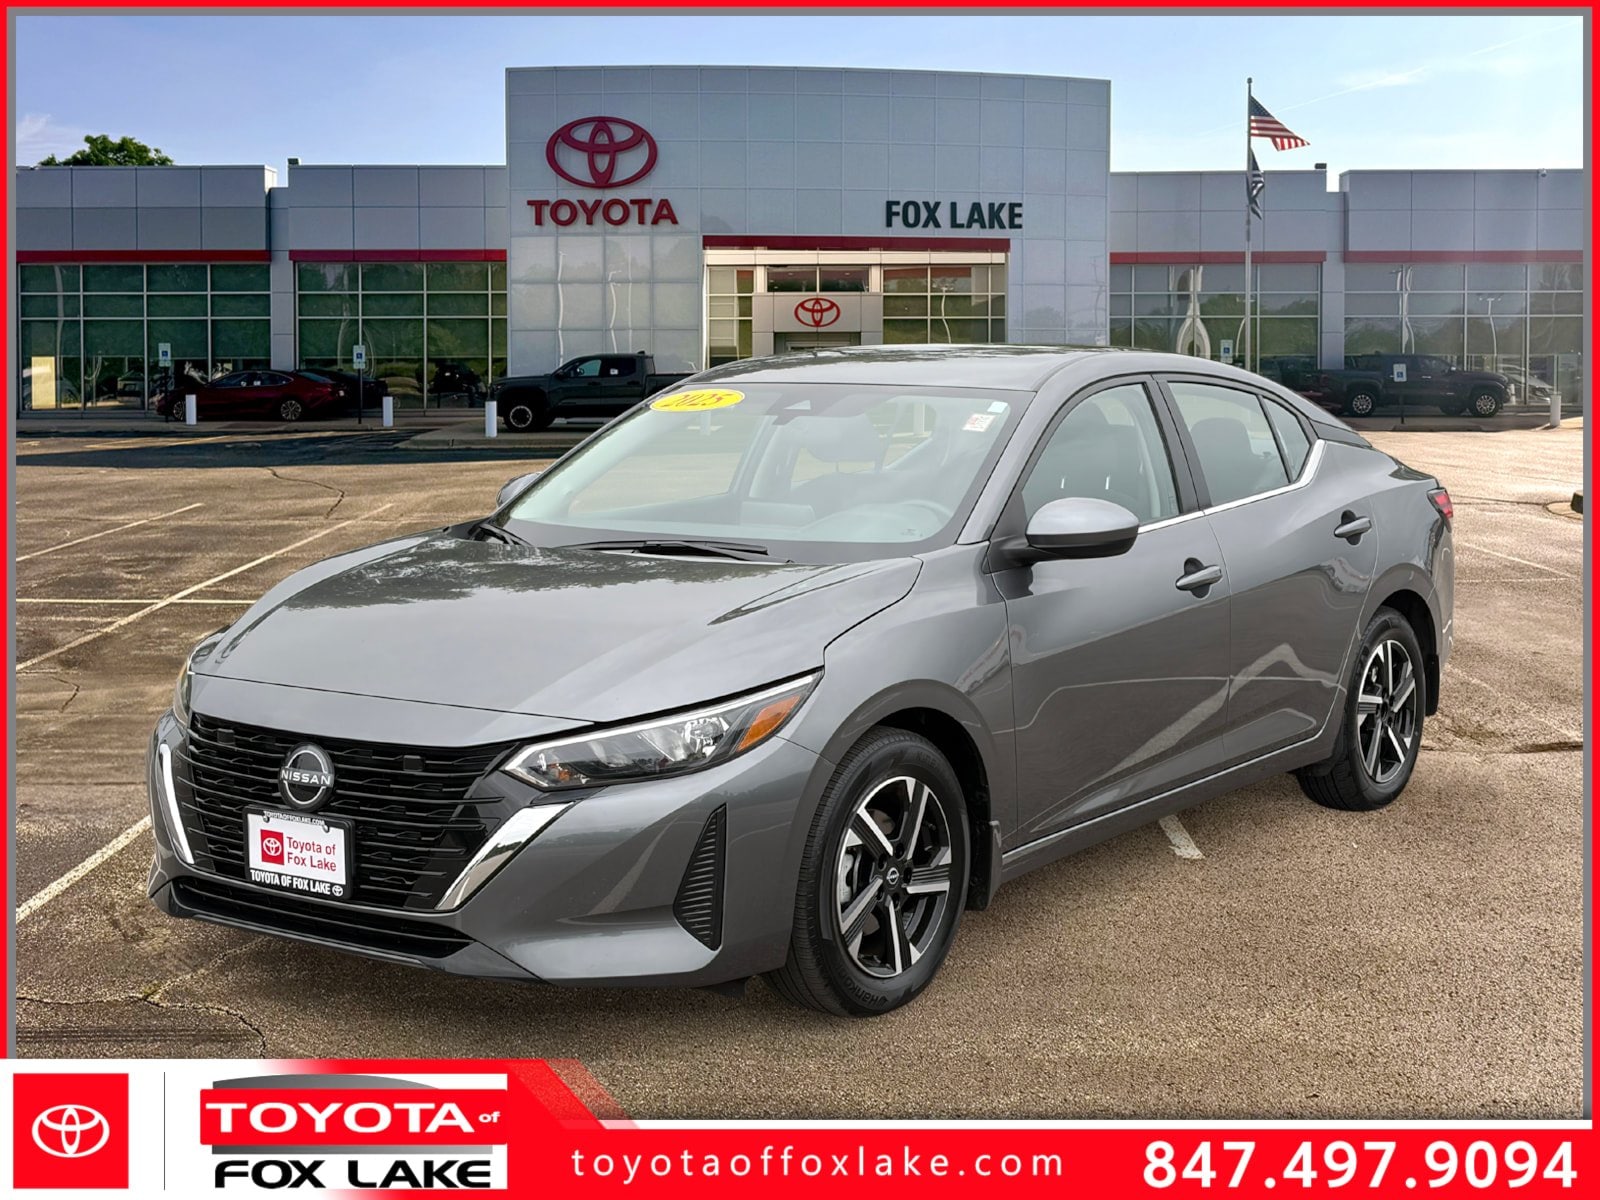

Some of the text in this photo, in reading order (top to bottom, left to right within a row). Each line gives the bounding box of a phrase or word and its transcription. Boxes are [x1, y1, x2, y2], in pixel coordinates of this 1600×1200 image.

[527, 198, 679, 227] TOYOTA
[885, 200, 1023, 230] FOX LAKE
[659, 393, 733, 407] 2025
[280, 769, 332, 785] NISSAN
[286, 836, 336, 855] Toyota of
[287, 851, 337, 872] Fox Lake
[250, 869, 331, 895] TOYOTA OF FOX LAKE
